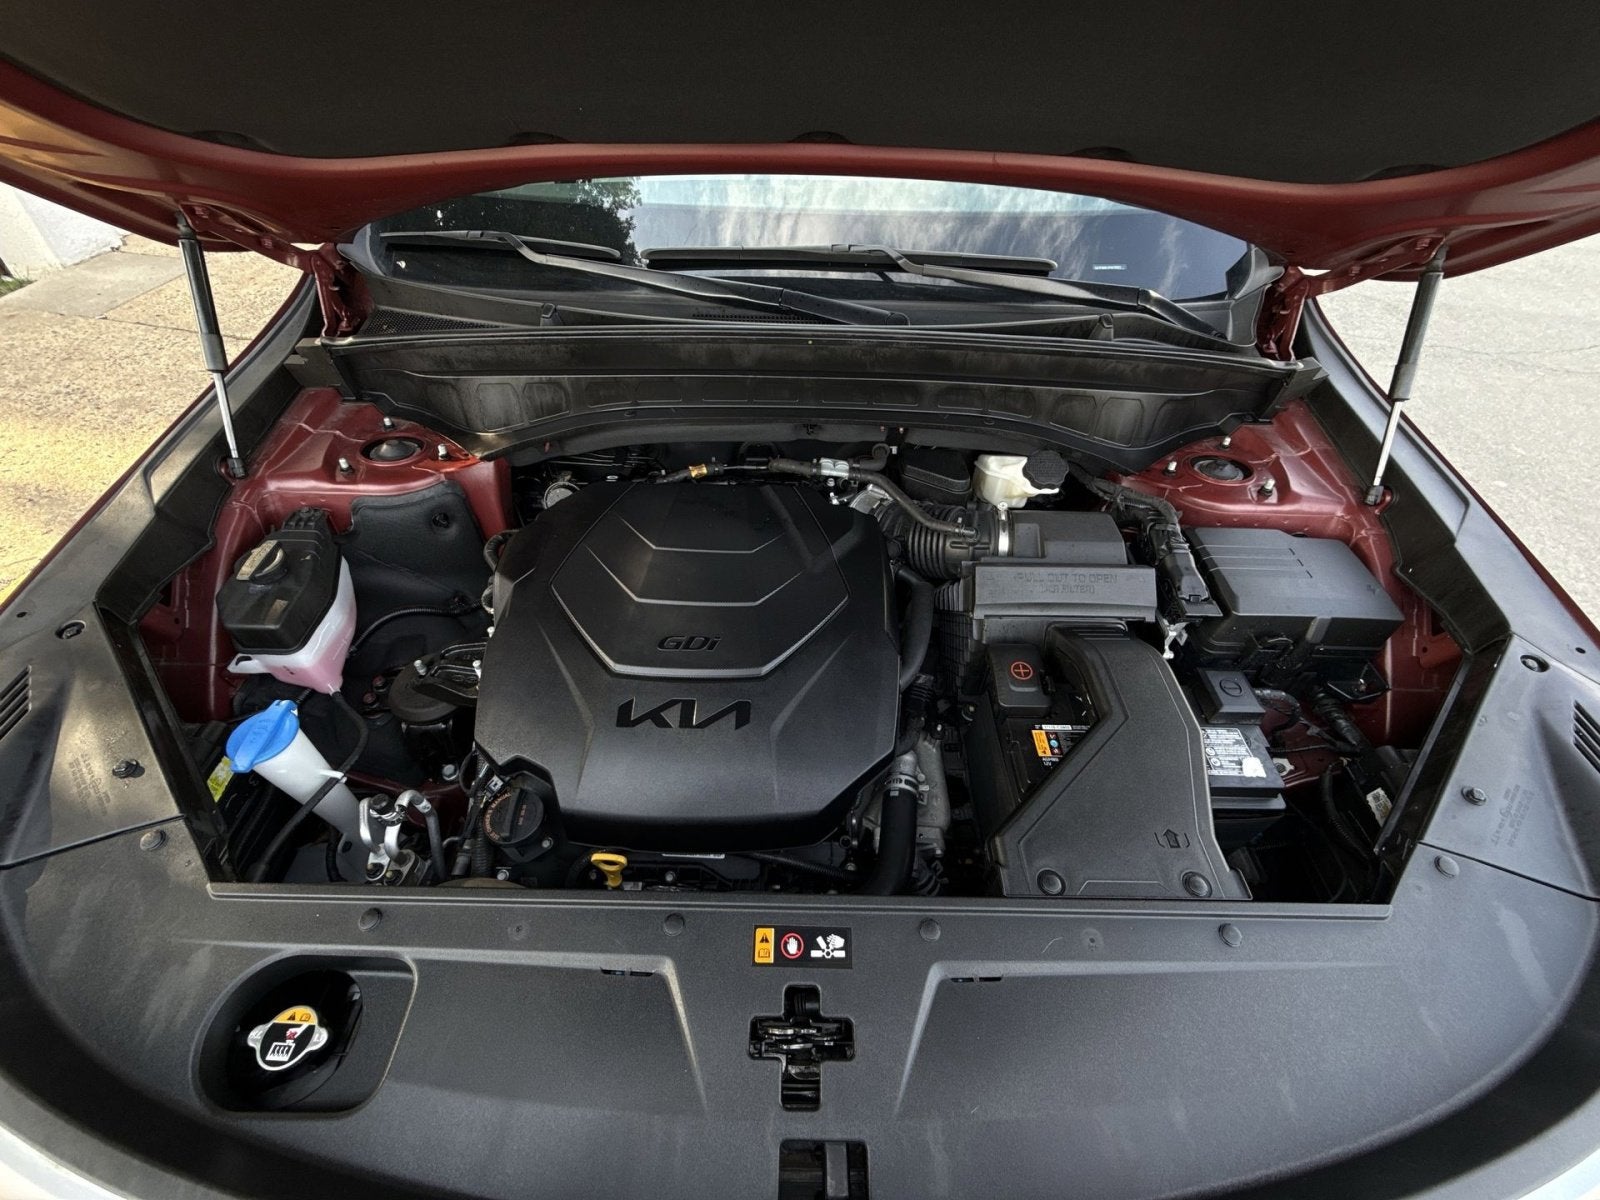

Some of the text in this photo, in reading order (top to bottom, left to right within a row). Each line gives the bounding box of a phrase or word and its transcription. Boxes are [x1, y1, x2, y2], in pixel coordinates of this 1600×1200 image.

[1015, 572, 1118, 584] PULL OUT TO OPEN
[657, 635, 722, 651] GDi
[616, 696, 752, 730] KIA
